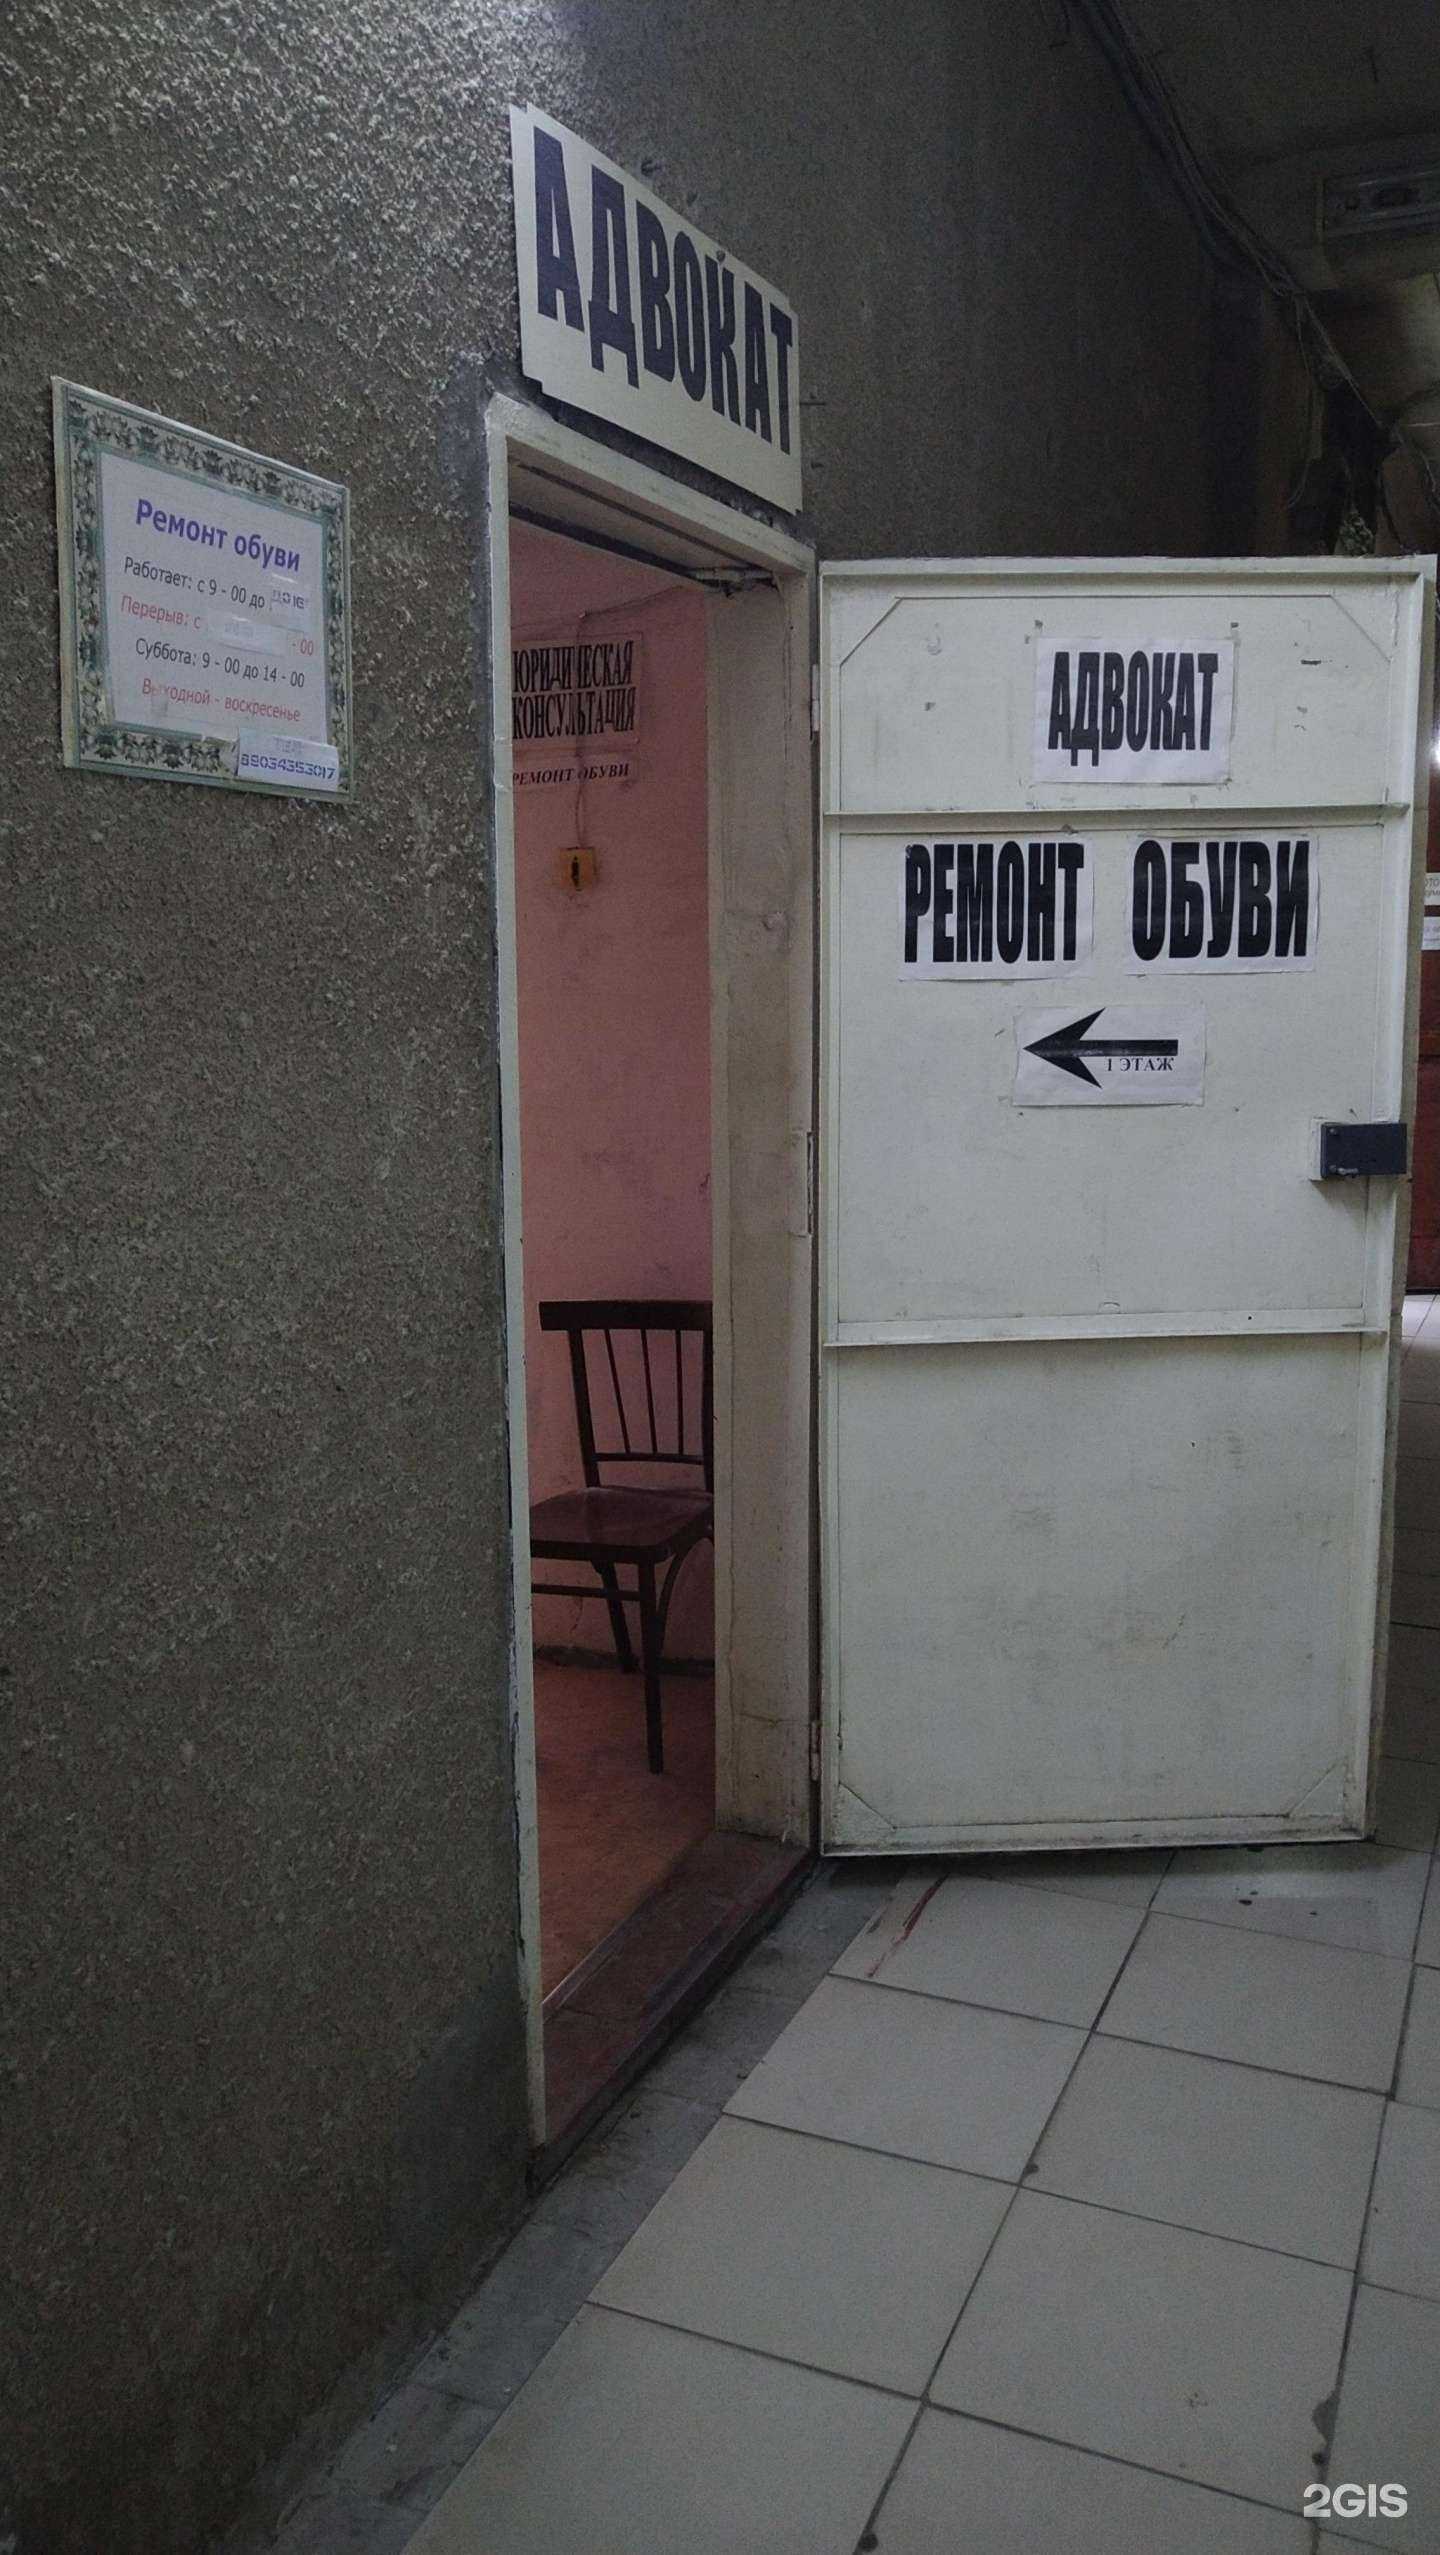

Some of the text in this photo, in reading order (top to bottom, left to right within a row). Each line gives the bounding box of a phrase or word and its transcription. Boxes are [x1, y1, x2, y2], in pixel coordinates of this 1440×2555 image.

[534, 126, 793, 456] АДВОКАТ
[136, 498, 301, 572] Ремонт обуви
[124, 556, 193, 590] Работает:
[197, 579, 206, 593] с
[209, 578, 218, 596] 9
[231, 585, 248, 604] 00
[249, 594, 266, 610] до
[120, 595, 189, 627] Перерыв:
[193, 616, 202, 630] с
[300, 638, 315, 656] 00
[135, 638, 198, 667] Суббота:
[202, 652, 211, 669] 9
[224, 657, 241, 675] 00
[242, 664, 260, 680] до
[263, 665, 278, 683] 14
[290, 671, 306, 688] 00
[224, 696, 302, 722] воскресенье
[511, 687, 636, 740] КОНСУЛЬТАЦИЯ
[1048, 651, 1219, 767] АДВОКАТ
[512, 763, 630, 786] РЕМОНТ ОБУВИ
[905, 840, 1311, 964] РЕМОНТ ОБУВИ
[1104, 1056, 1176, 1072] 1 ЭТАЖ
